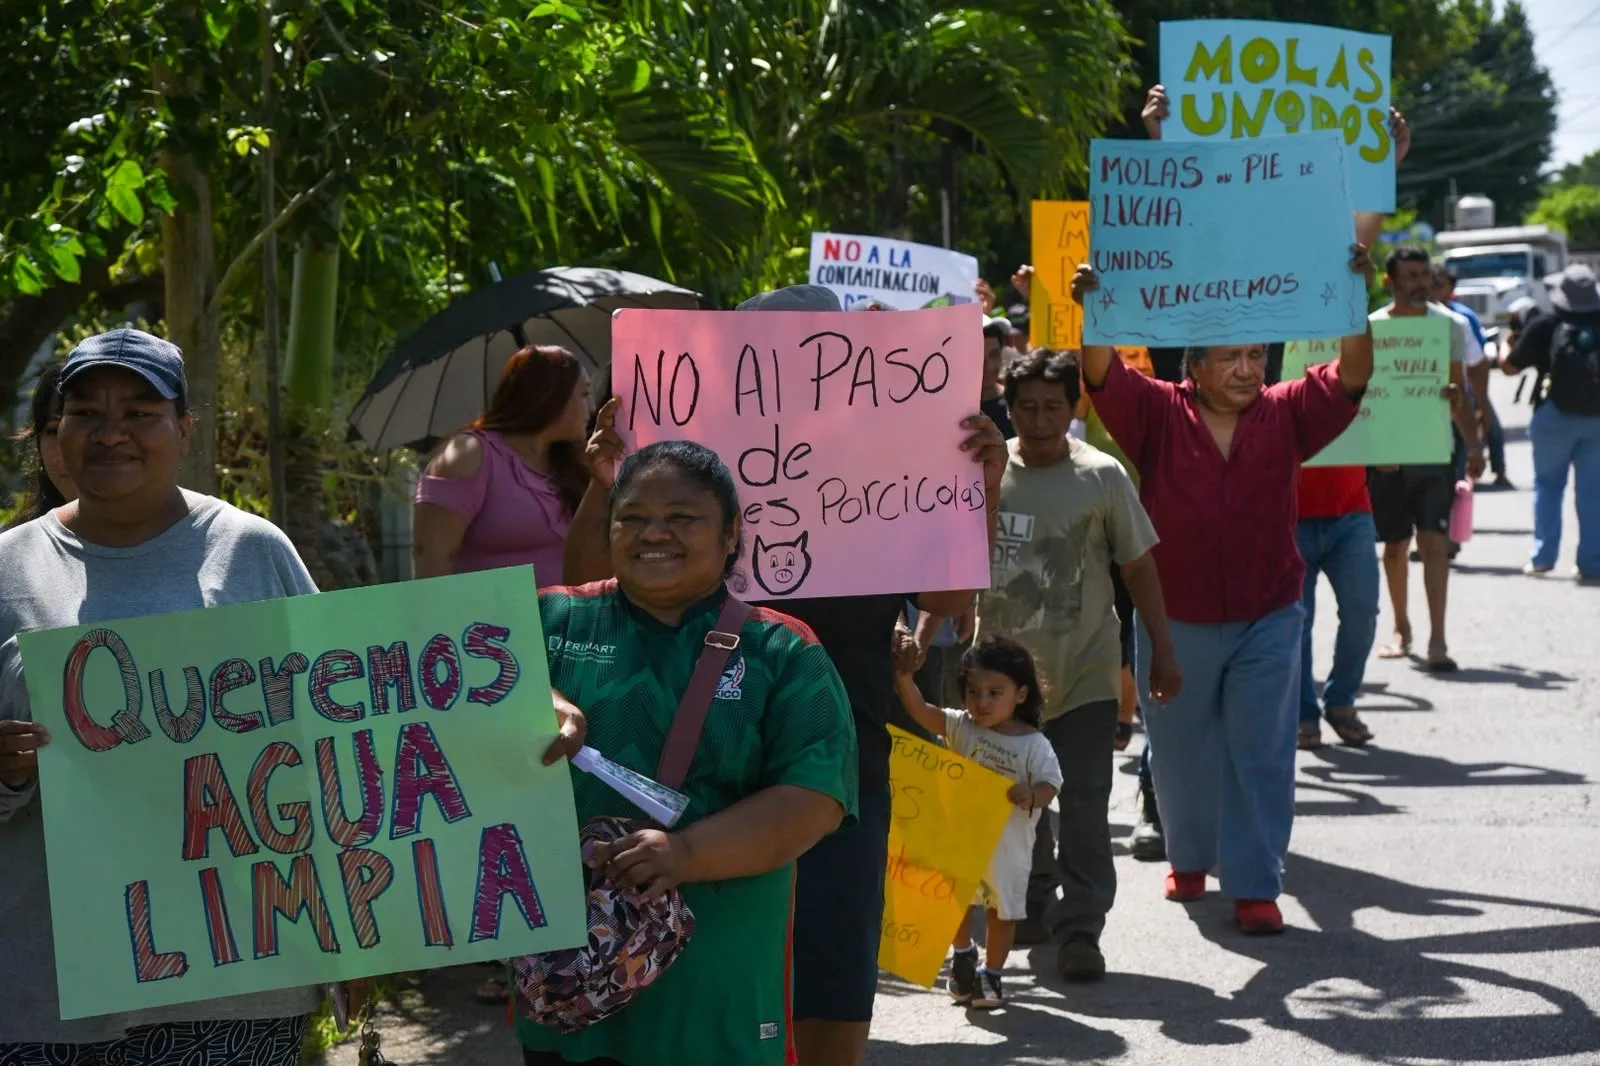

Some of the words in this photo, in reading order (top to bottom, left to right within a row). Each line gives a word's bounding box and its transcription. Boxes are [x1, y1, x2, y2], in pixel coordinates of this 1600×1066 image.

[1184, 34, 1383, 103] MOLAS
[1101, 155, 1203, 189] MOLAS
[1242, 152, 1283, 184] PIE
[824, 238, 861, 262] NO
[868, 245, 880, 264] A
[889, 248, 912, 268] LA
[1094, 250, 1174, 273] UNIDOS
[1140, 272, 1300, 310] VENCEREMOS
[629, 350, 700, 430] NO
[800, 329, 952, 410] PASÓ
[738, 424, 812, 487] de
[182, 721, 472, 861] AGUA
[125, 823, 548, 983] LIMPIA
